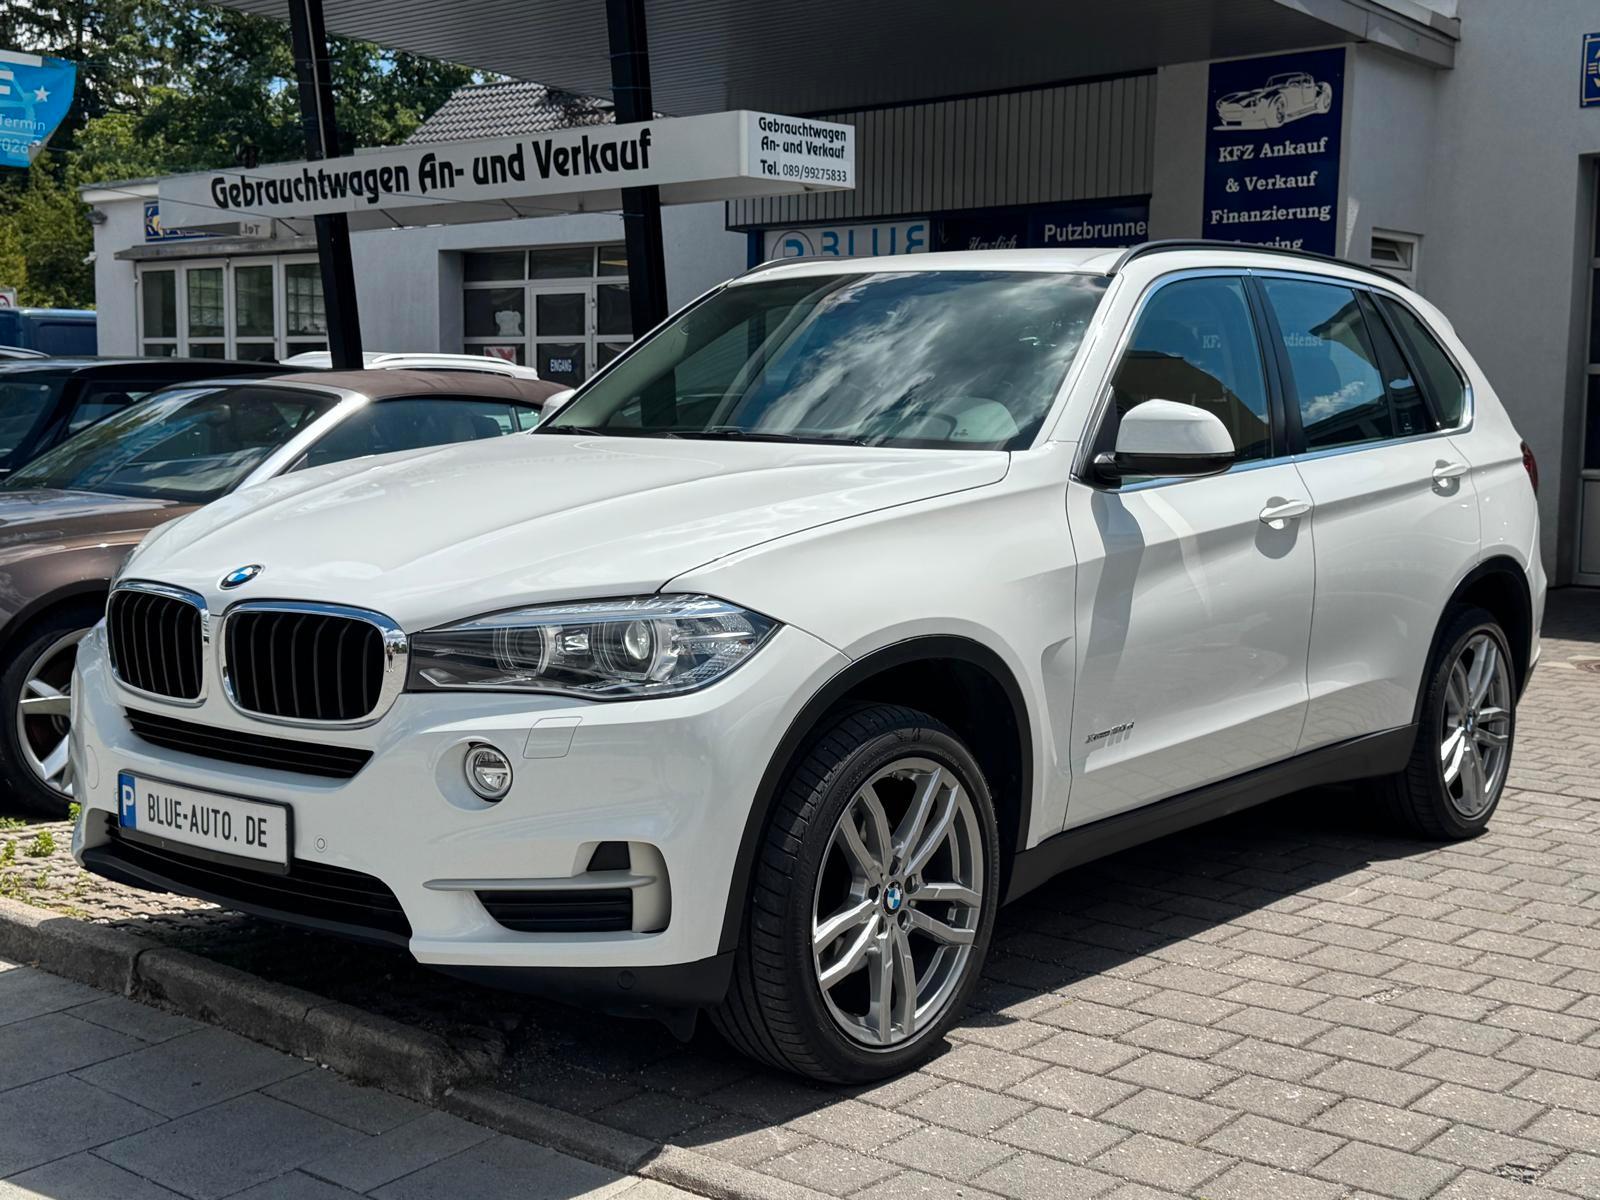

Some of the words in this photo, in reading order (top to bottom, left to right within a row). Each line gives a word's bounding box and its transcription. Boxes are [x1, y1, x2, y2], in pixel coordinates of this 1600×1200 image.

[758, 117, 847, 143] Gebrauchtwagen
[761, 136, 780, 151] An-
[783, 140, 802, 155] und
[805, 141, 845, 159] Verkauf
[1218, 144, 1254, 162] KFZ
[1259, 137, 1328, 158] Ankauf
[211, 168, 410, 209] Gebrauchtwagen
[418, 152, 464, 194] An-
[473, 143, 525, 185] und
[532, 128, 652, 179] Verkauf
[760, 159, 780, 176] Tel.
[782, 164, 847, 182] 089/99275833
[1225, 178, 1240, 192] &
[1244, 171, 1318, 191] Verkauf
[1210, 205, 1331, 225] Finanzierung
[550, 359, 572, 372] EINGANG
[122, 785, 135, 816] P
[246, 815, 267, 848] DE
